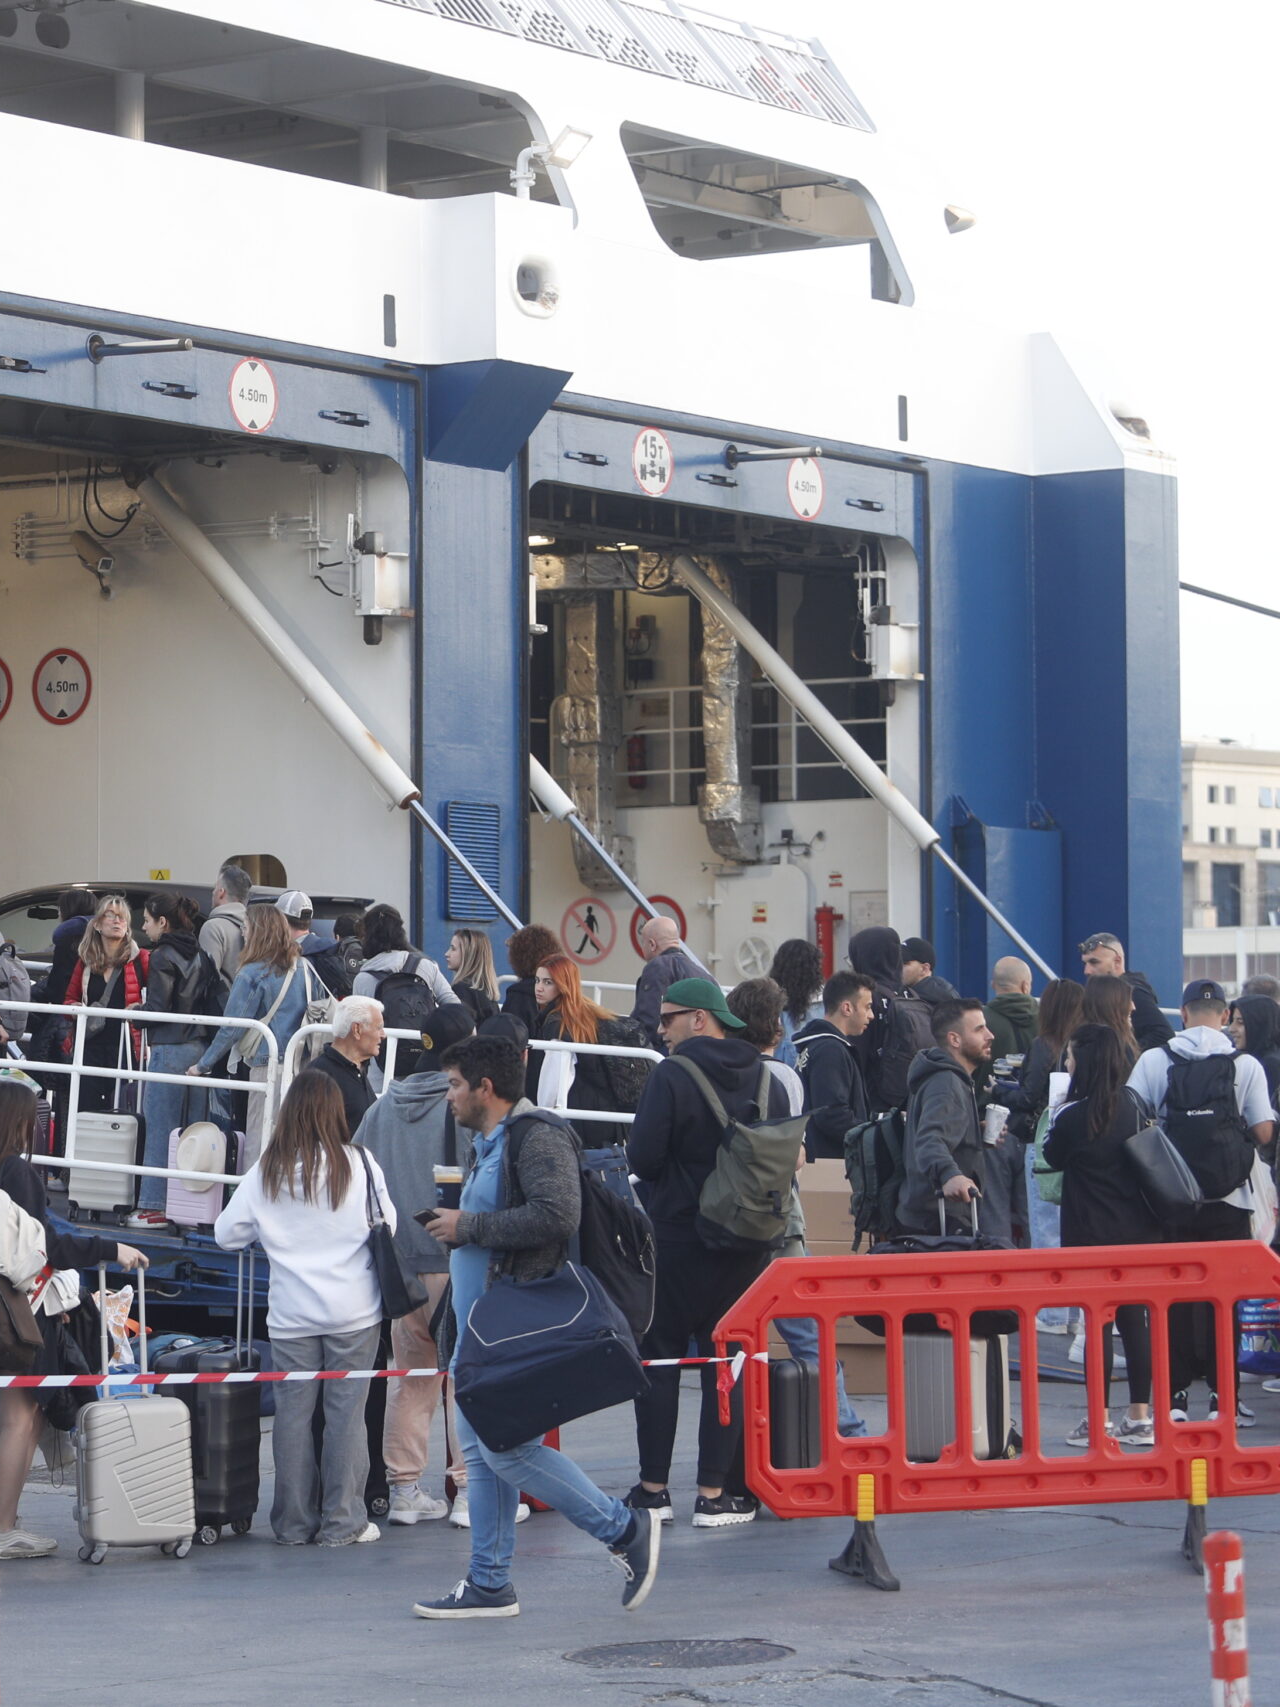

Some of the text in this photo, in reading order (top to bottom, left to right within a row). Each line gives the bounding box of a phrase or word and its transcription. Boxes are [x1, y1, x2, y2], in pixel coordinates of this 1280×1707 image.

[238, 387, 268, 404] 4.50m
[794, 480, 817, 494] 4.50m
[46, 680, 79, 694] 4.50m
